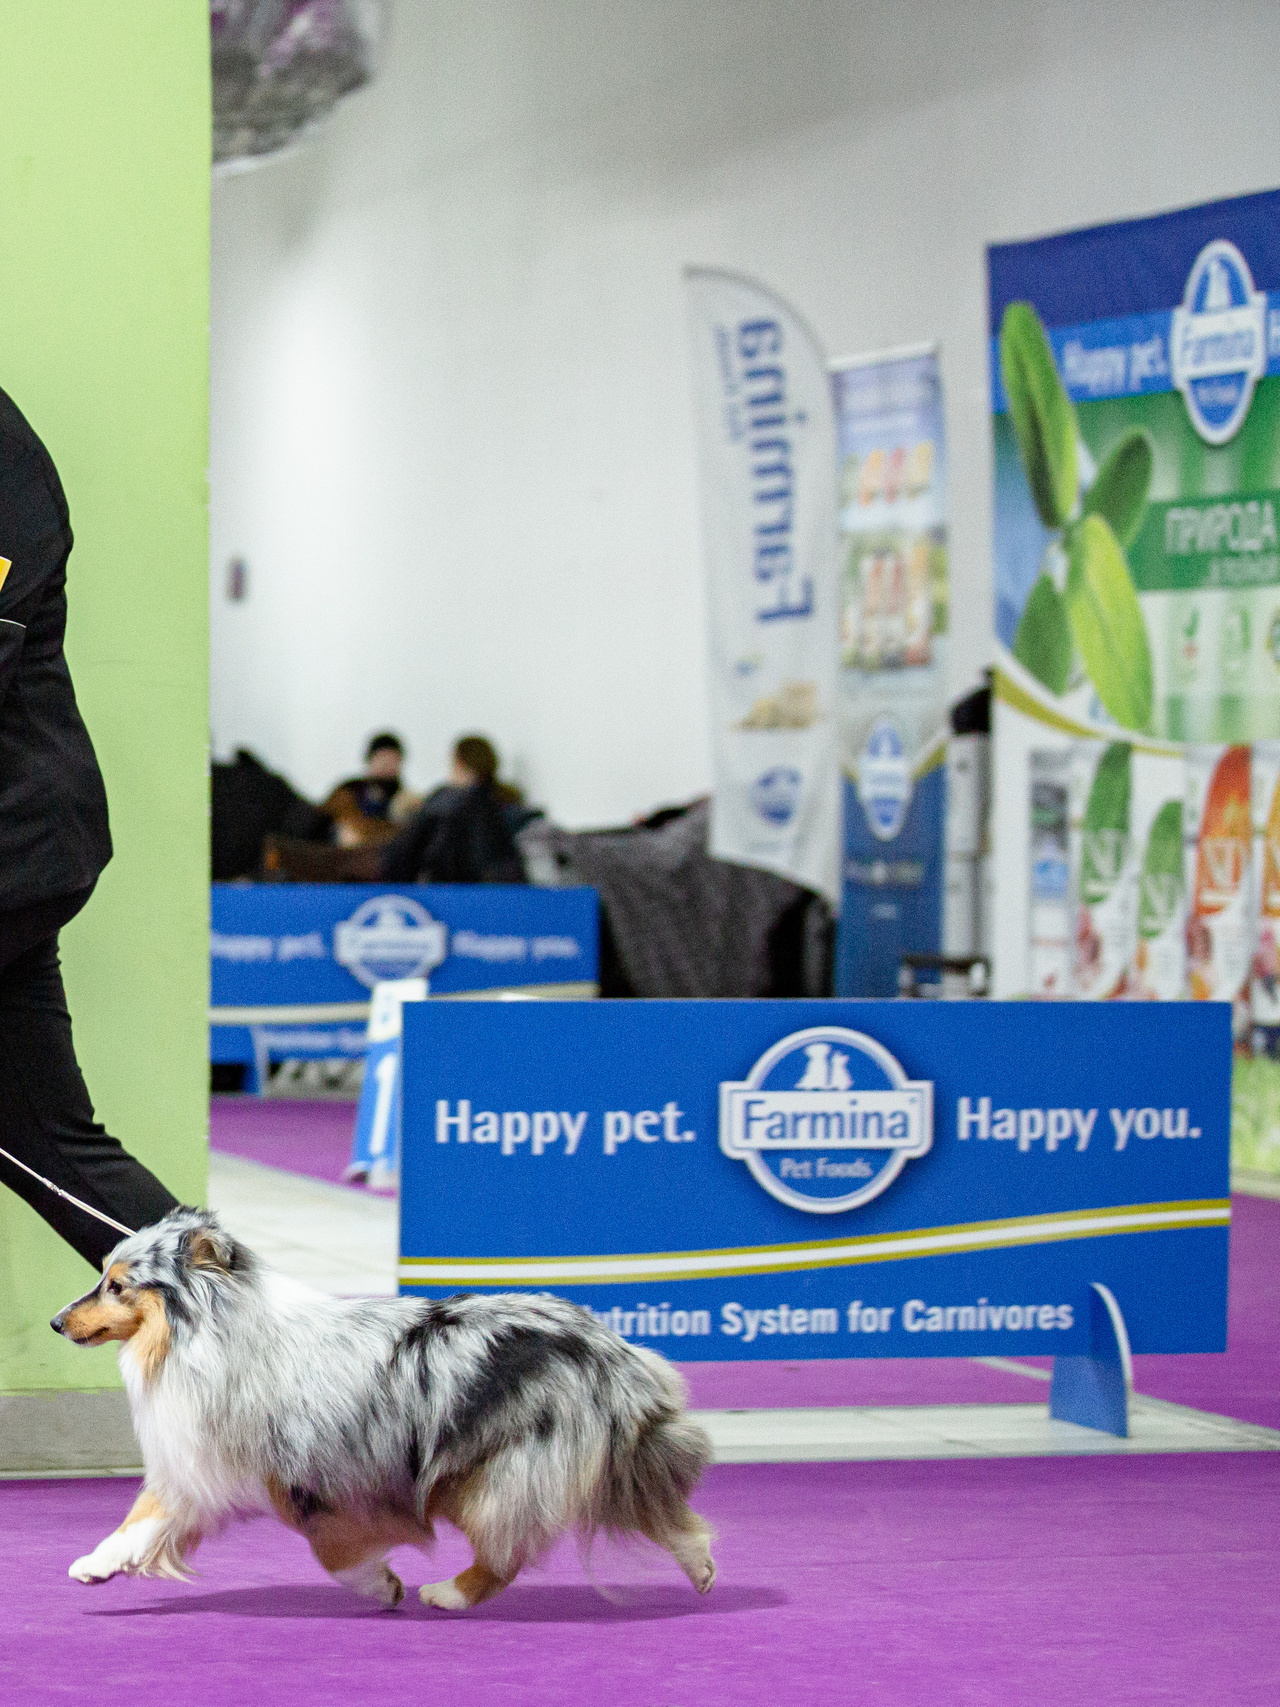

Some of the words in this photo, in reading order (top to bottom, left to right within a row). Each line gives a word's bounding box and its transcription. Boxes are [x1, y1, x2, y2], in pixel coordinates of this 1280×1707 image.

[435, 1099, 588, 1155] Happy
[603, 1101, 696, 1155] pet.
[742, 1099, 911, 1141] Farmina
[957, 1096, 1099, 1152] Happy
[1109, 1106, 1202, 1151] you.
[779, 1157, 812, 1178] Pet
[816, 1157, 874, 1179] Foods
[583, 1302, 711, 1337] utrition
[721, 1301, 840, 1343] System
[847, 1300, 895, 1334] for
[902, 1297, 1075, 1333] Carnivores
